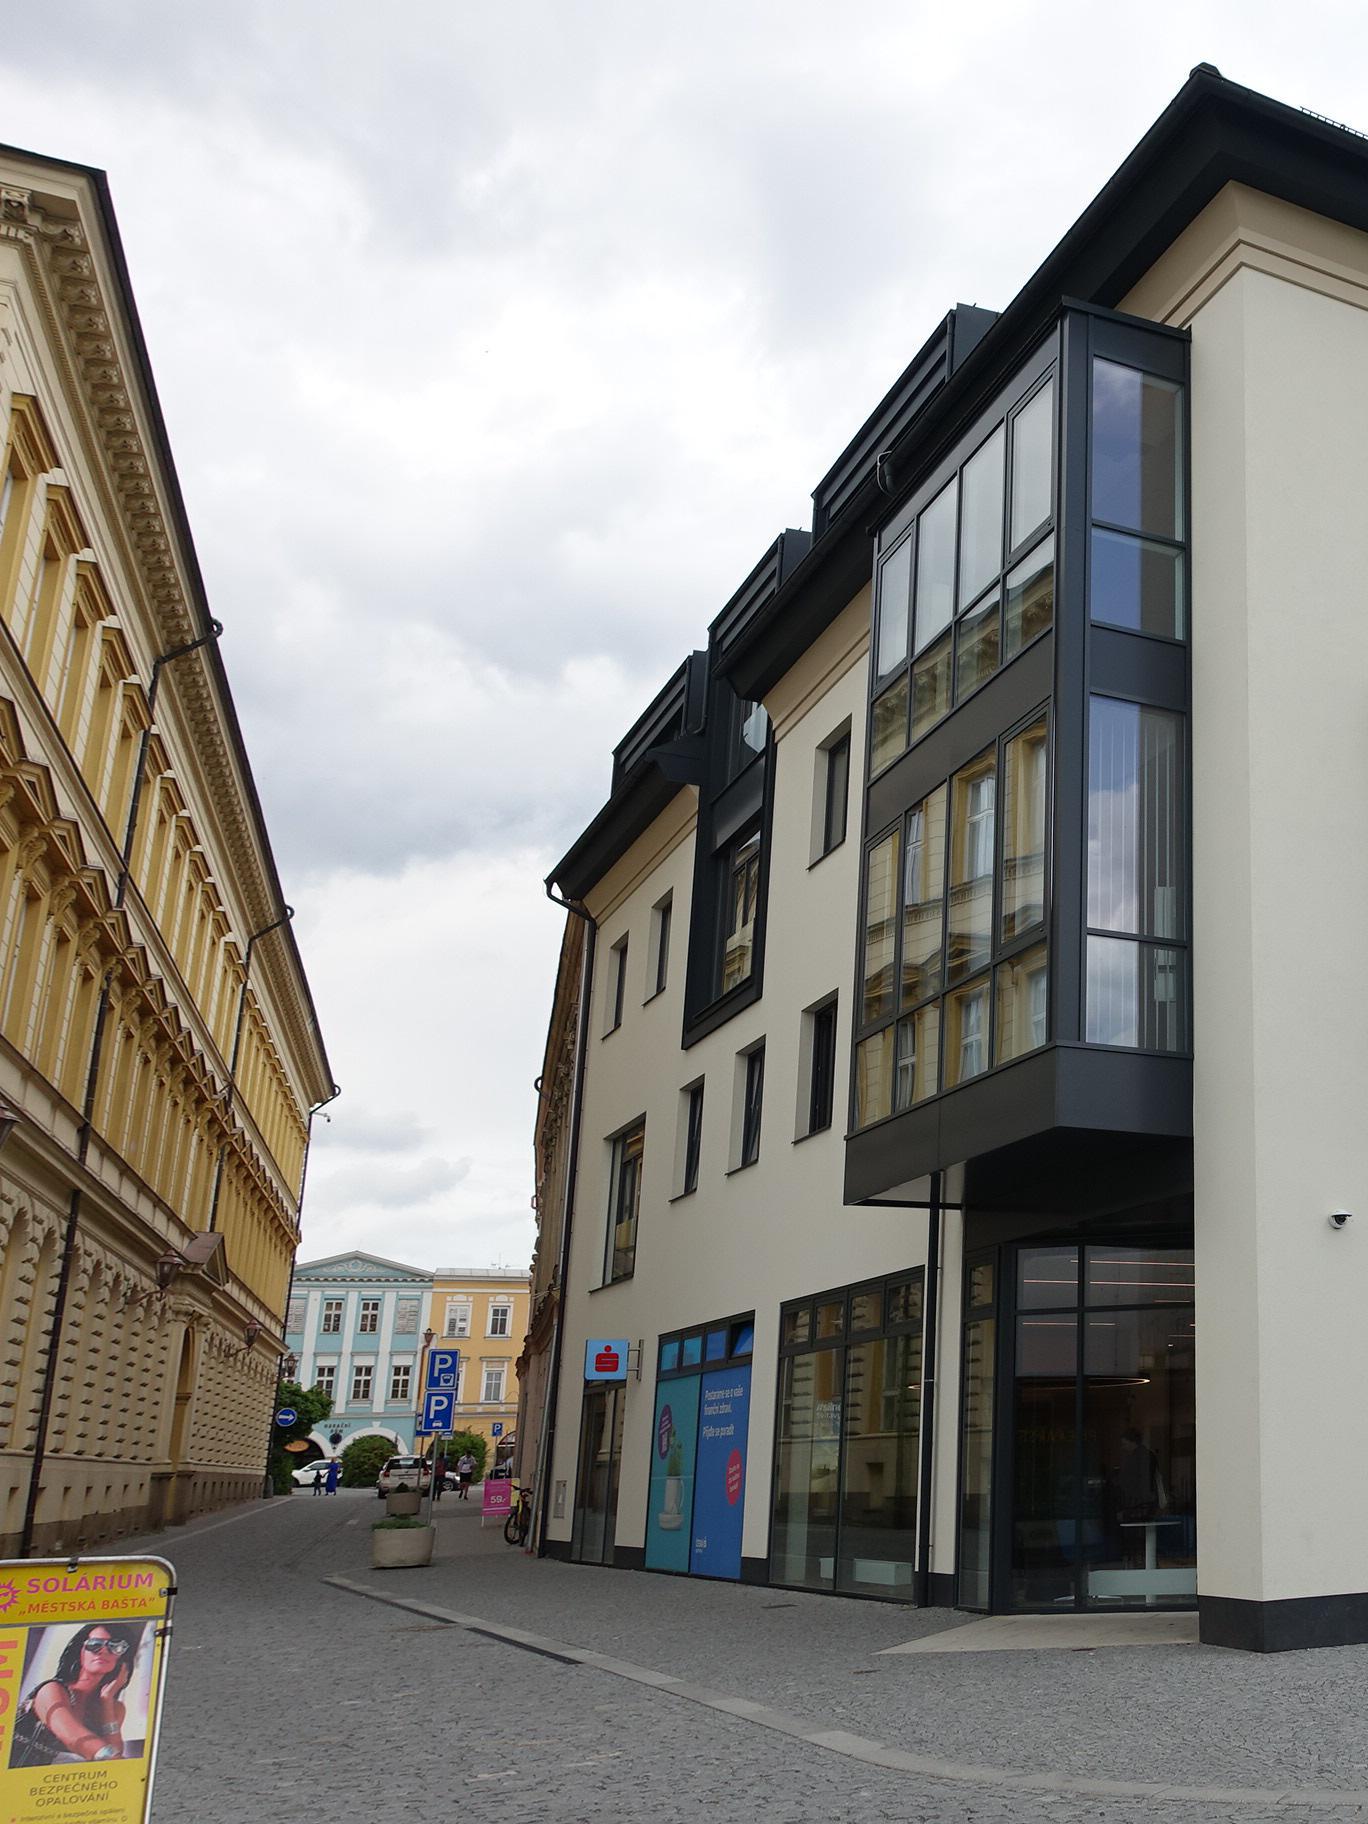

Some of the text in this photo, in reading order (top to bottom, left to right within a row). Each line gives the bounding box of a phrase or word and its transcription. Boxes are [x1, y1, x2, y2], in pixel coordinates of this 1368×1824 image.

[433, 1354, 453, 1377] P
[429, 1396, 448, 1419] P
[493, 1423, 501, 1433] P
[26, 1572, 154, 1594] SOLÁRIUM
[43, 1770, 107, 1783] CENTRUM
[29, 1780, 118, 1796] BEZPEČNÉHO
[35, 1791, 109, 1807] OPALOVÁNÍ
